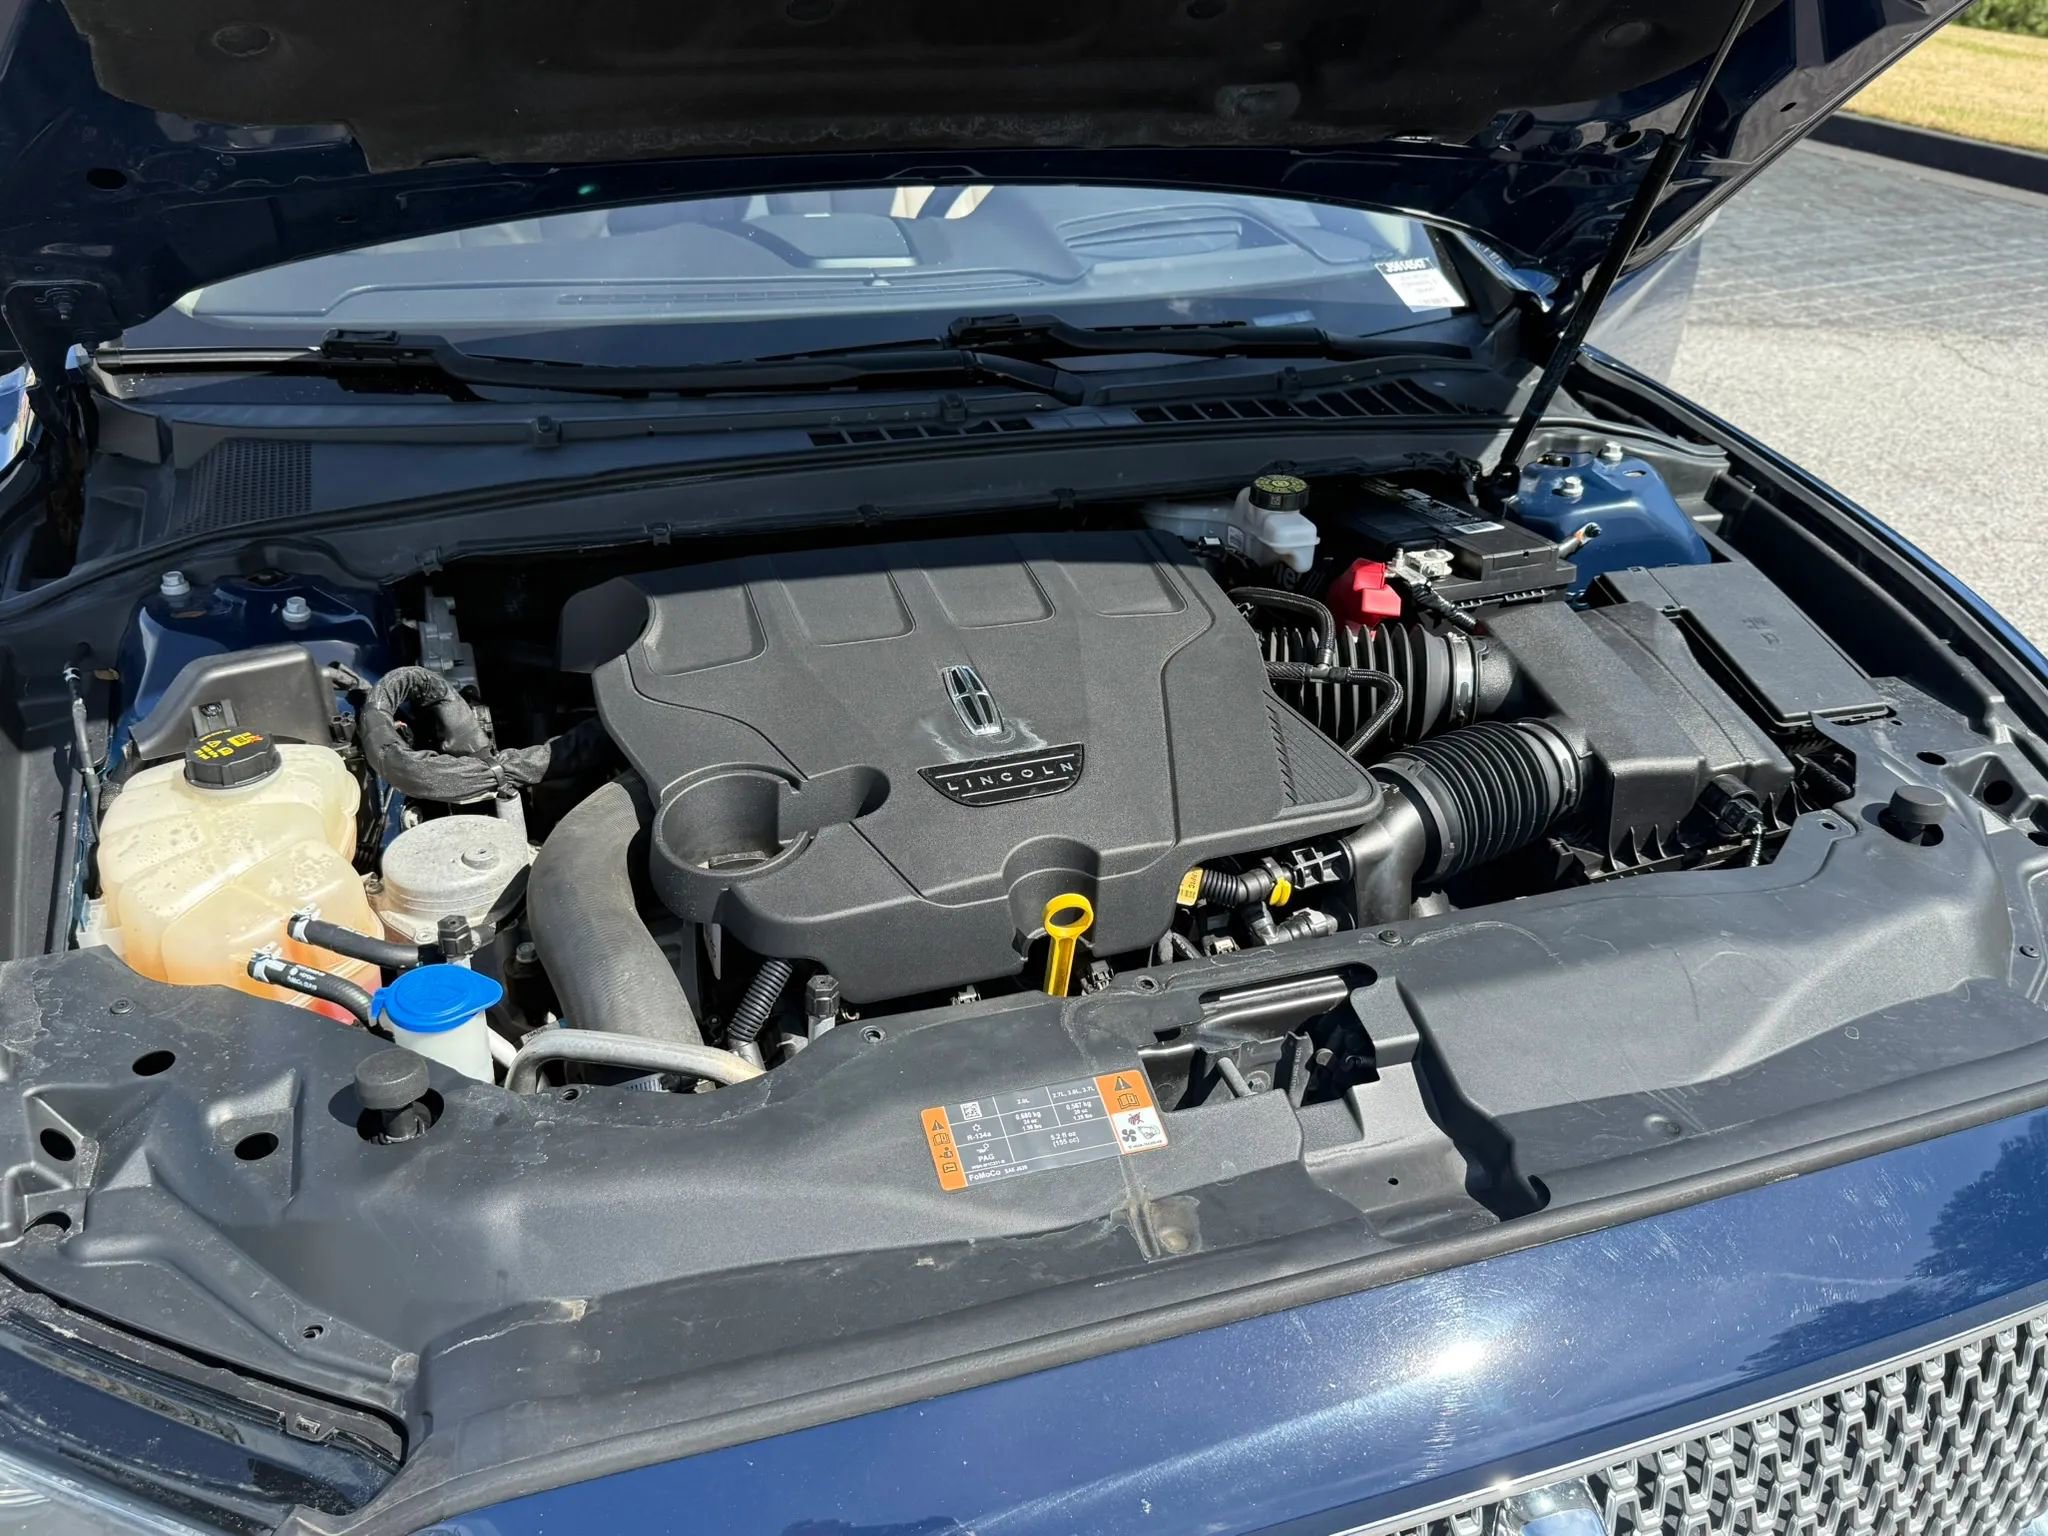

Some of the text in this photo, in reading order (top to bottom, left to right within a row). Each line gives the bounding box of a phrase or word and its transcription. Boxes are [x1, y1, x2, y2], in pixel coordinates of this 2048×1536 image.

[946, 762, 1074, 791] LINCOLN
[1032, 1111, 1042, 1119] kg
[966, 1132, 992, 1141] R-134a
[1050, 1133, 1061, 1141] 5.2
[1068, 1136, 1080, 1144] cc)
[978, 1153, 995, 1163] PAG
[968, 1169, 1001, 1182] FoMoCo
